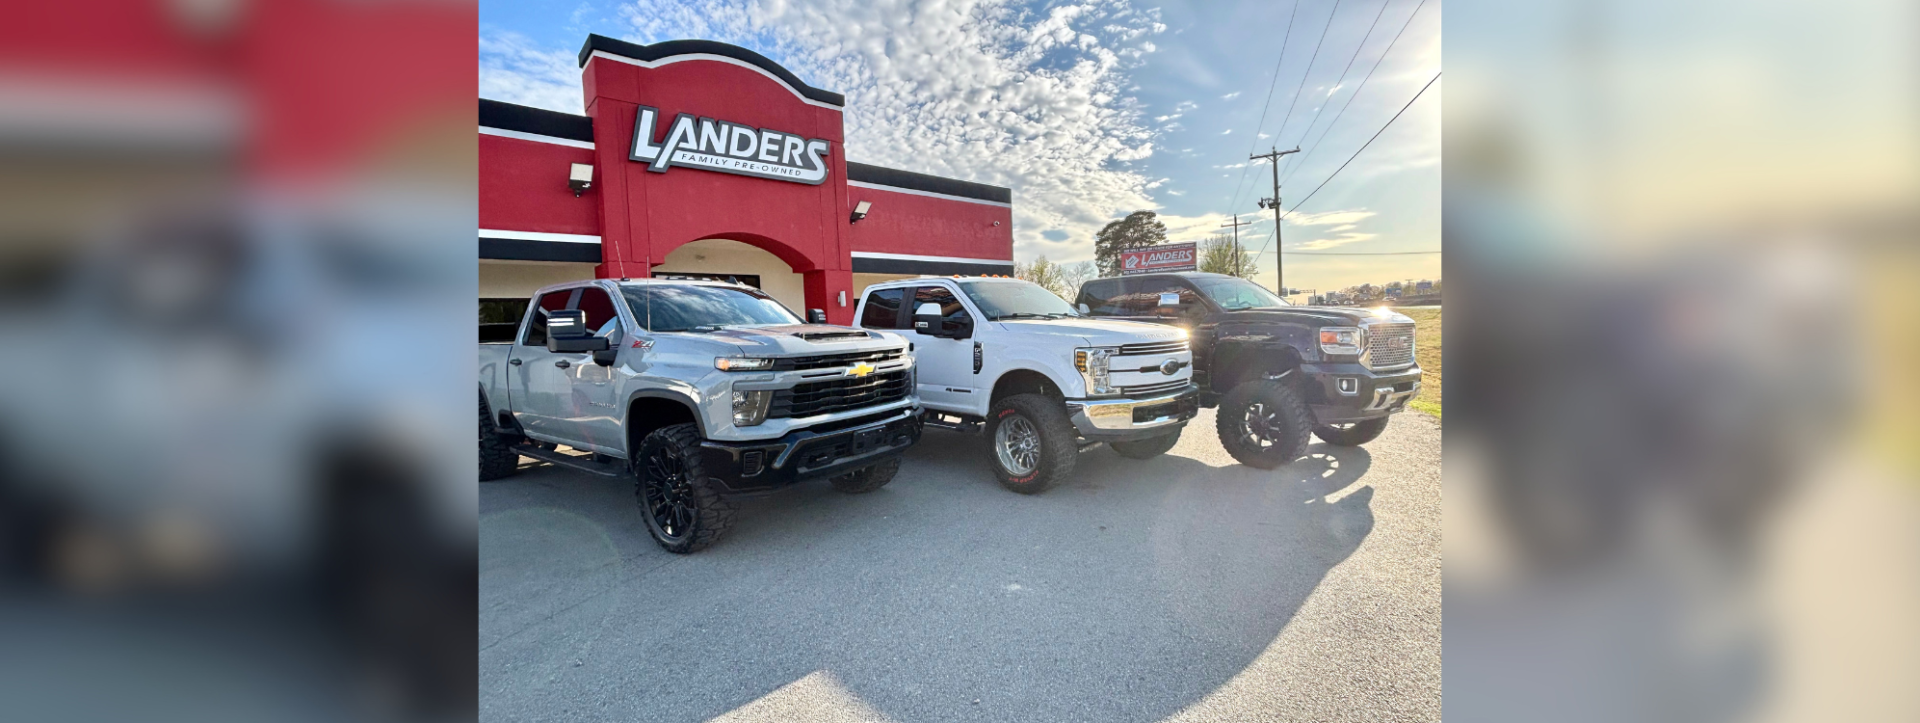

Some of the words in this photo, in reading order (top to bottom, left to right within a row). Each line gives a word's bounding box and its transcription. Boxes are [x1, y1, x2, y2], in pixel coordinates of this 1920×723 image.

[634, 109, 829, 181] LANDERS
[681, 153, 728, 166] FAMILY
[734, 161, 802, 177] PRE-OWNED
[1141, 249, 1193, 266] LANDERS
